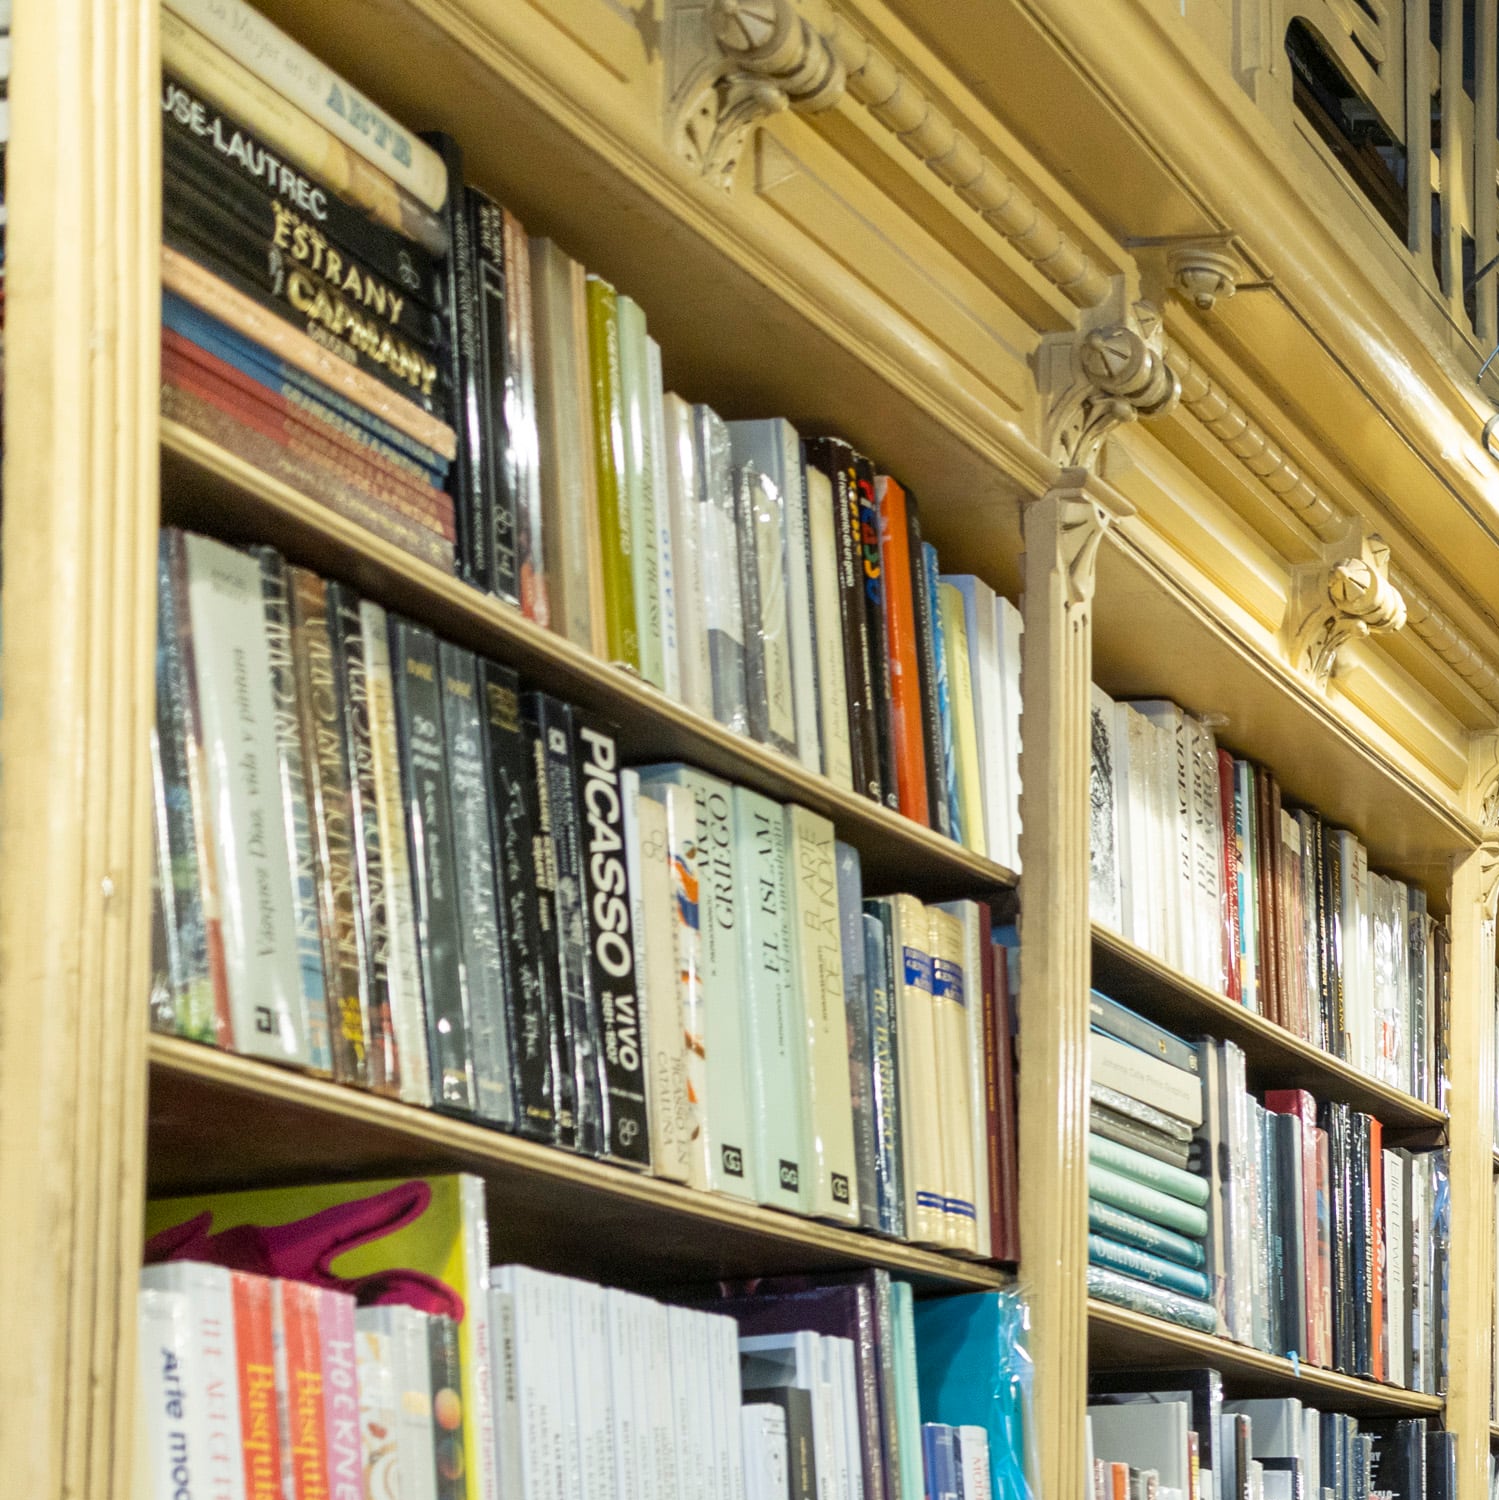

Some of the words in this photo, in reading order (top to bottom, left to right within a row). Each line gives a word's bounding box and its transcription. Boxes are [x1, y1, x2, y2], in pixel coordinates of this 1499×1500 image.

[273, 211, 403, 324] ESTRANY
[838, 471, 848, 482] el
[839, 483, 852, 534] nacimiento
[842, 536, 852, 546] de
[843, 548, 853, 559] un
[844, 561, 857, 588] genio
[1174, 720, 1192, 881] DELACROIX
[706, 793, 735, 931] GRIEGO
[752, 810, 778, 917] ISLAM
[797, 826, 818, 892] ARTE
[814, 838, 836, 910] INDIA
[579, 726, 632, 978] PICASSO
[614, 993, 639, 1071] VIVO
[803, 909, 821, 931] EL
[762, 931, 782, 973] EL
[820, 916, 839, 958] LA
[824, 960, 842, 998] DE
[160, 1347, 184, 1420] Arte
